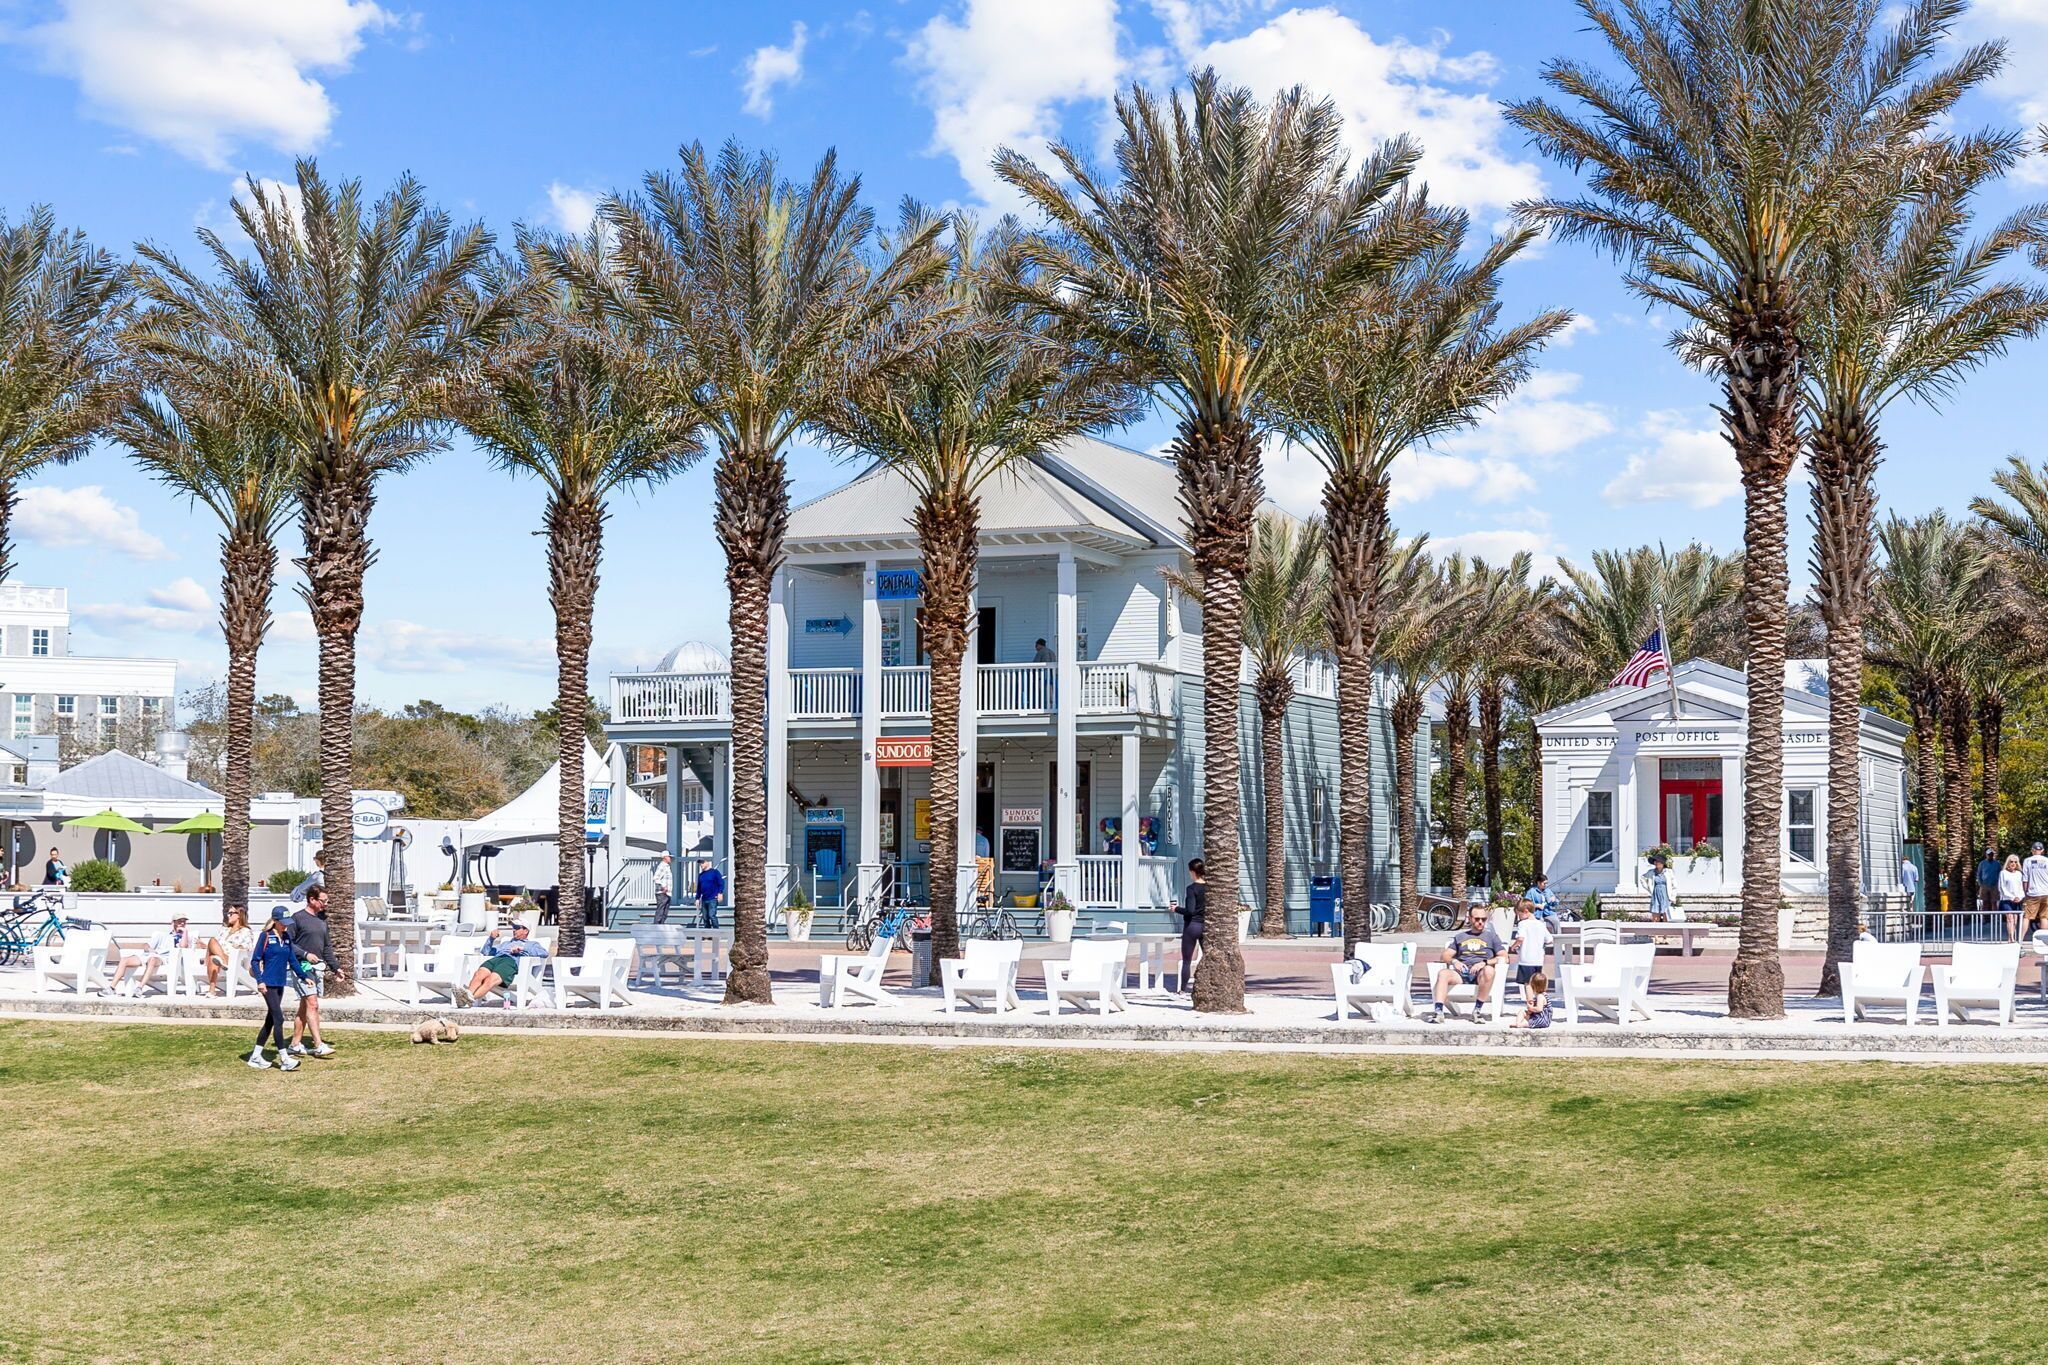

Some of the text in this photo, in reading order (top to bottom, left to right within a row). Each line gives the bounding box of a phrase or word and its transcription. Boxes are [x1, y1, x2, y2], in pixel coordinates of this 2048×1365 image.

[879, 574, 914, 590] CENTRAL
[1546, 736, 1619, 747] UNITED STA
[1635, 731, 1720, 742] POST OFFICE
[877, 745, 921, 758] SUNDOG
